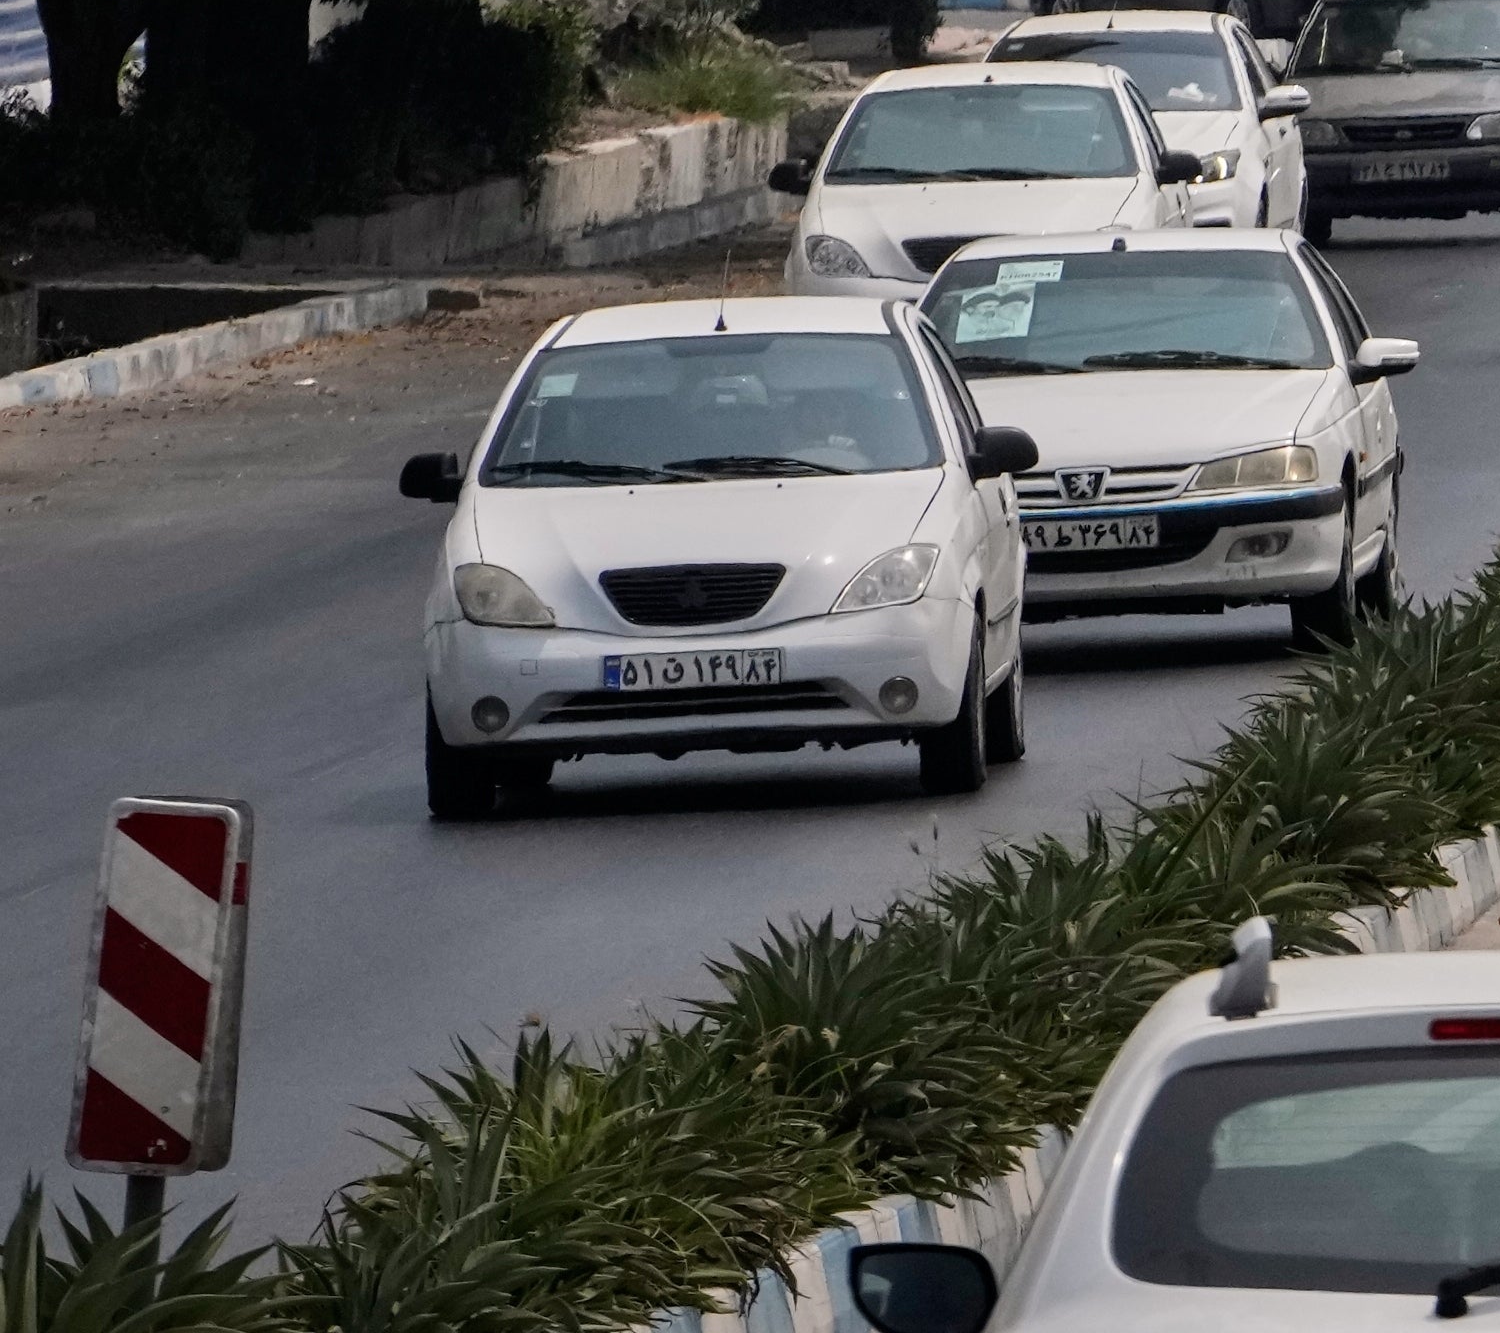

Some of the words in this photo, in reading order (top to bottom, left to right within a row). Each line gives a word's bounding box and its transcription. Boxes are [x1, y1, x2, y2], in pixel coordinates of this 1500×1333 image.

[1054, 524, 1073, 548] ط
[622, 658, 654, 687] ۵۱
[663, 657, 685, 684] ق
[693, 655, 740, 684] ۱۴۹
[745, 658, 777, 683] ۸۴
